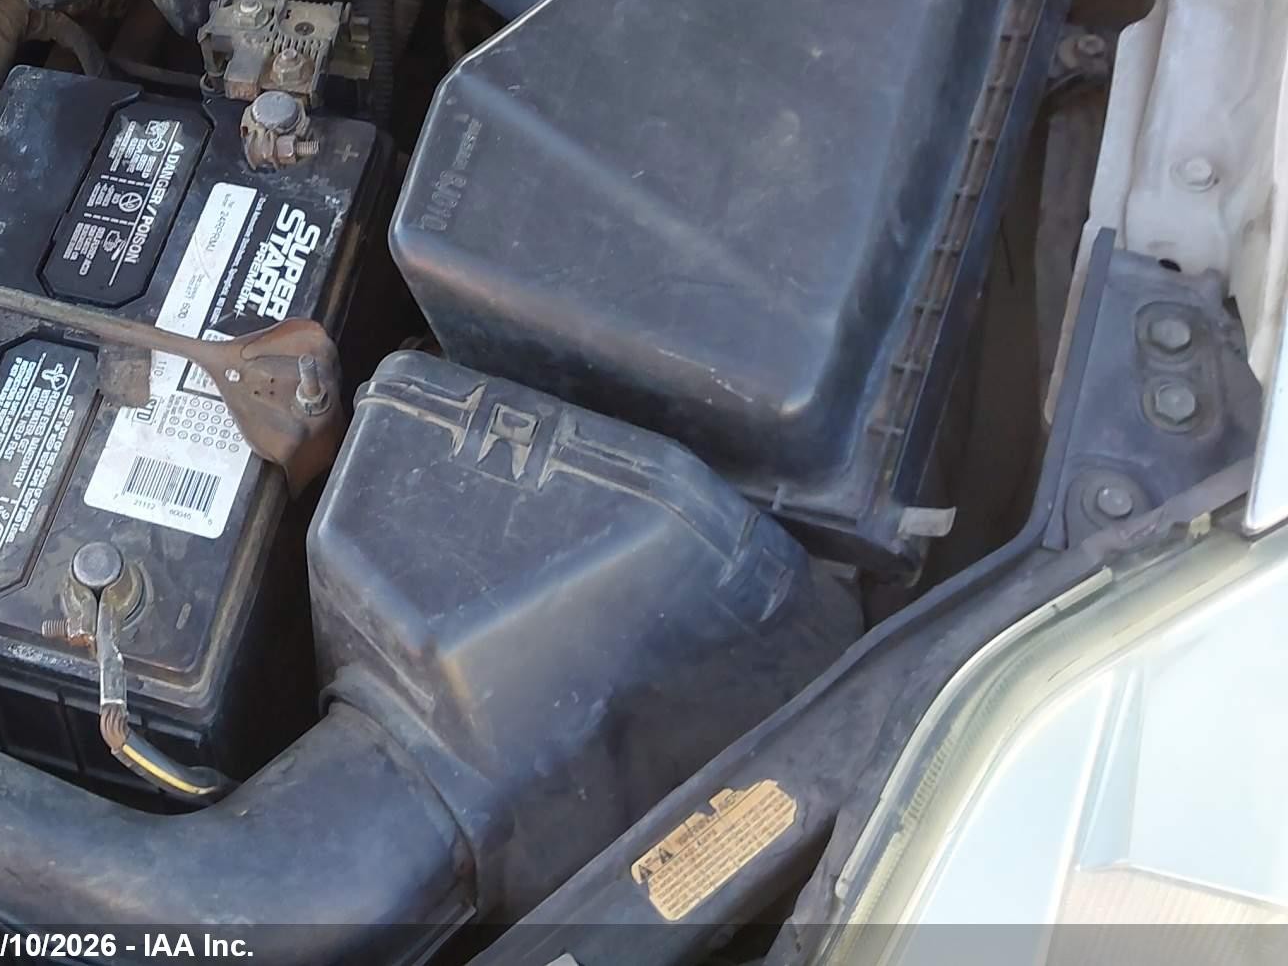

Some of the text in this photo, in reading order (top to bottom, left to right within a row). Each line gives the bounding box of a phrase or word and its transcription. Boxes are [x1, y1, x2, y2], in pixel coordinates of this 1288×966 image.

[150, 155, 179, 204] DANGER
[125, 216, 154, 262] POISON
[241, 205, 304, 314] START
[264, 222, 319, 319] SUPER
[235, 243, 270, 310] PREMIUM
